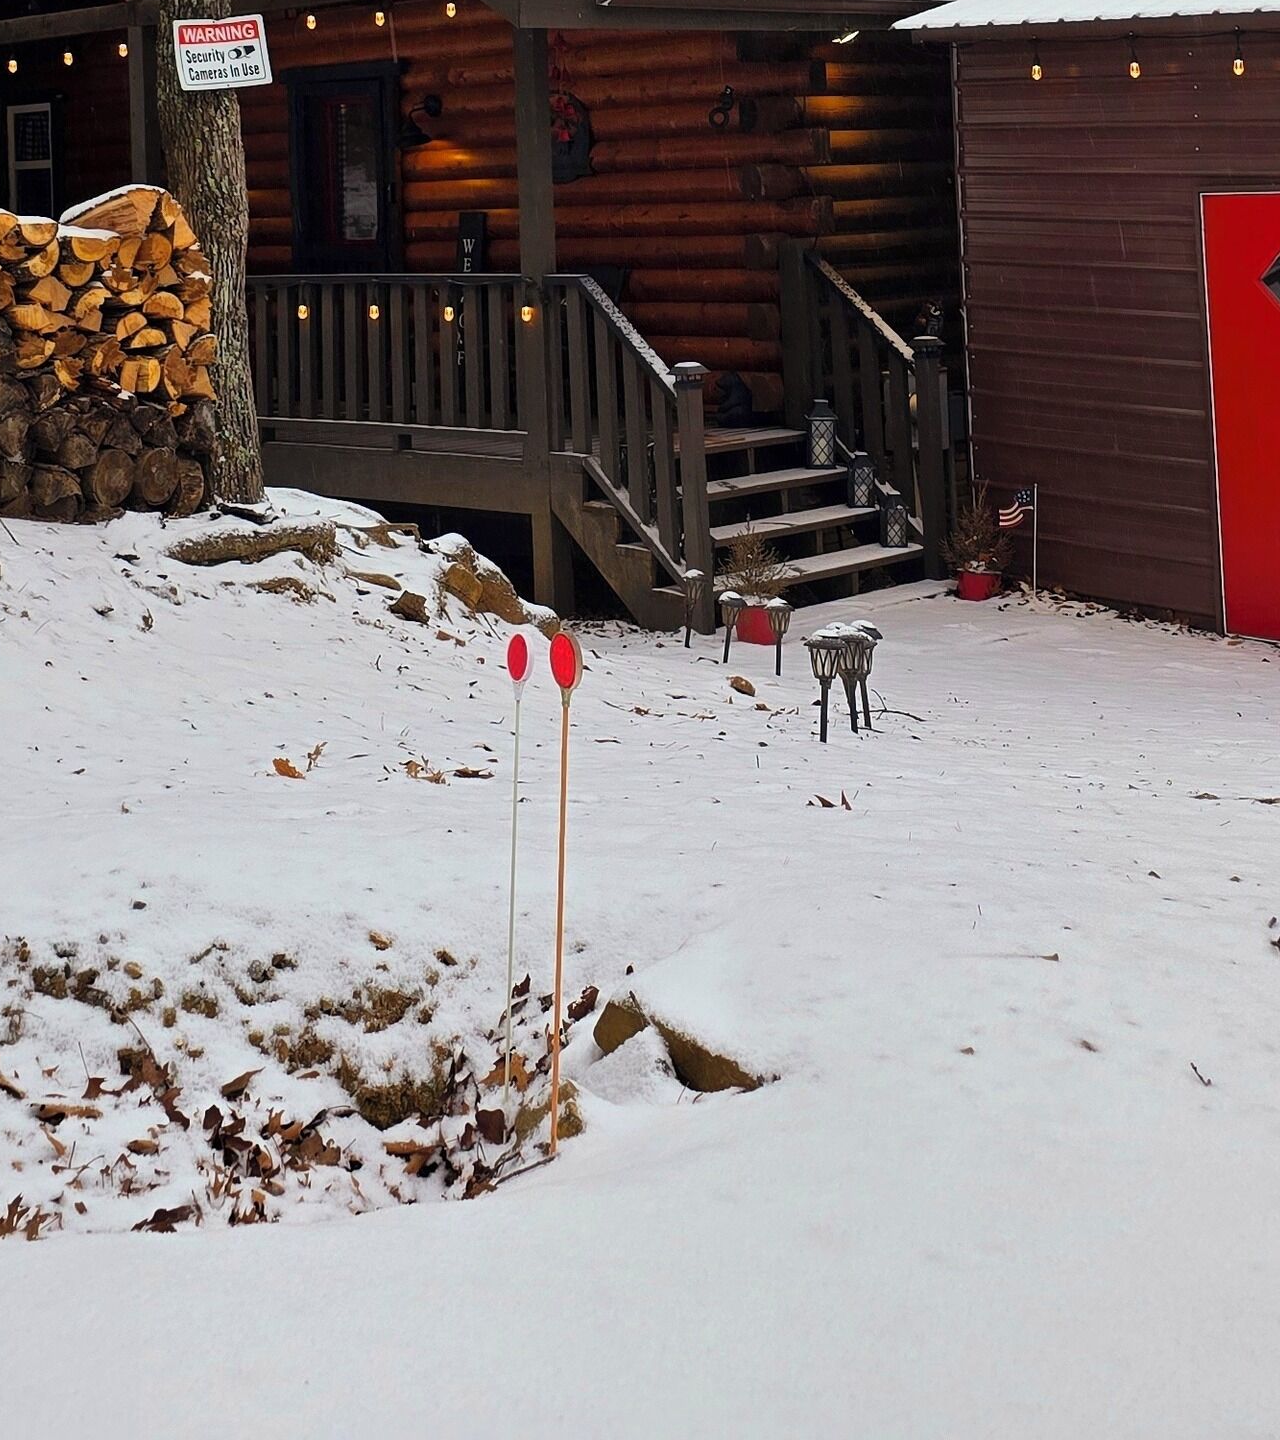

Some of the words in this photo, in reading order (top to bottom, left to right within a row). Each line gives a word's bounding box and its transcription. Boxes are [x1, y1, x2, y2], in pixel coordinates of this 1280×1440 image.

[183, 23, 255, 43] WARNING
[186, 49, 225, 64] Security
[188, 67, 228, 81] Cameras
[230, 64, 240, 77] In
[242, 63, 260, 76] Use
